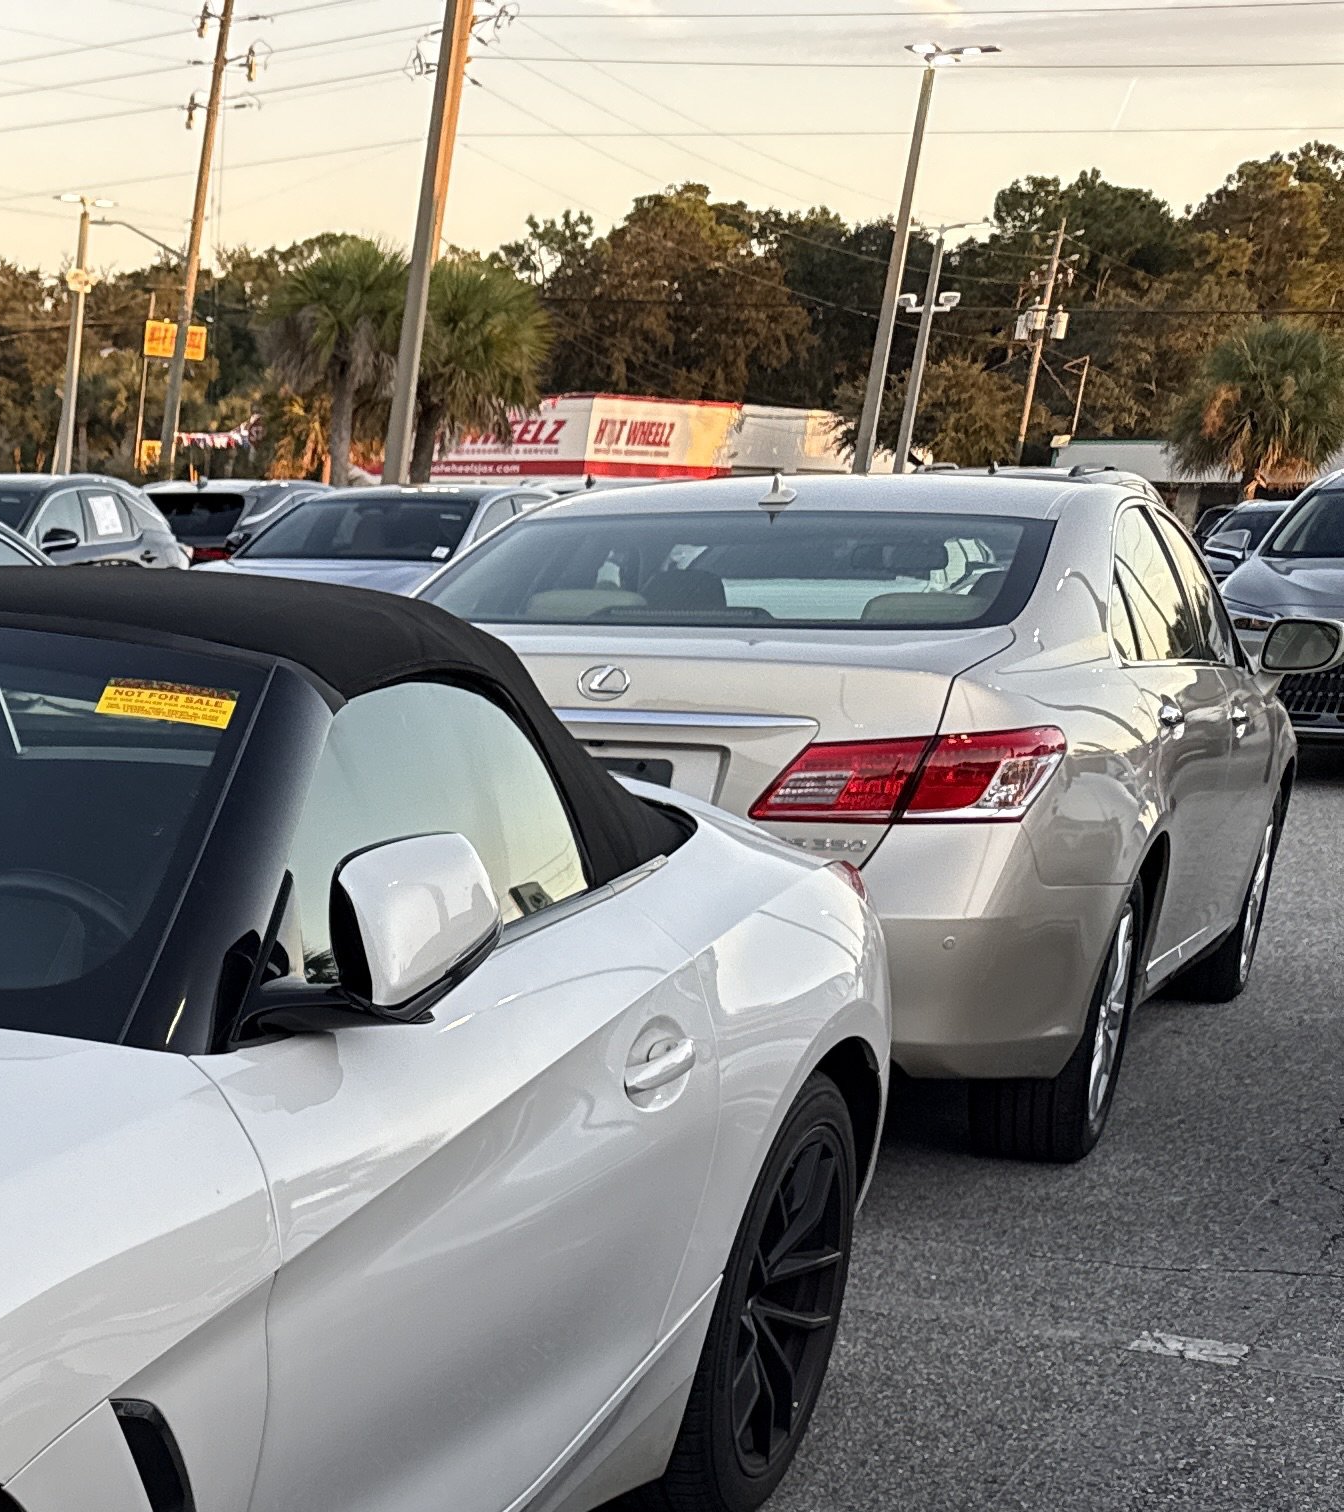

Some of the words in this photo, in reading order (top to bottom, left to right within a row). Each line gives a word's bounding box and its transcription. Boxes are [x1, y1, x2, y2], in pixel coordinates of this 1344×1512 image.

[625, 420, 676, 447] WHEELZ
[113, 689, 144, 698] NOT
[149, 692, 179, 702] FOR
[184, 696, 224, 708] SALE
